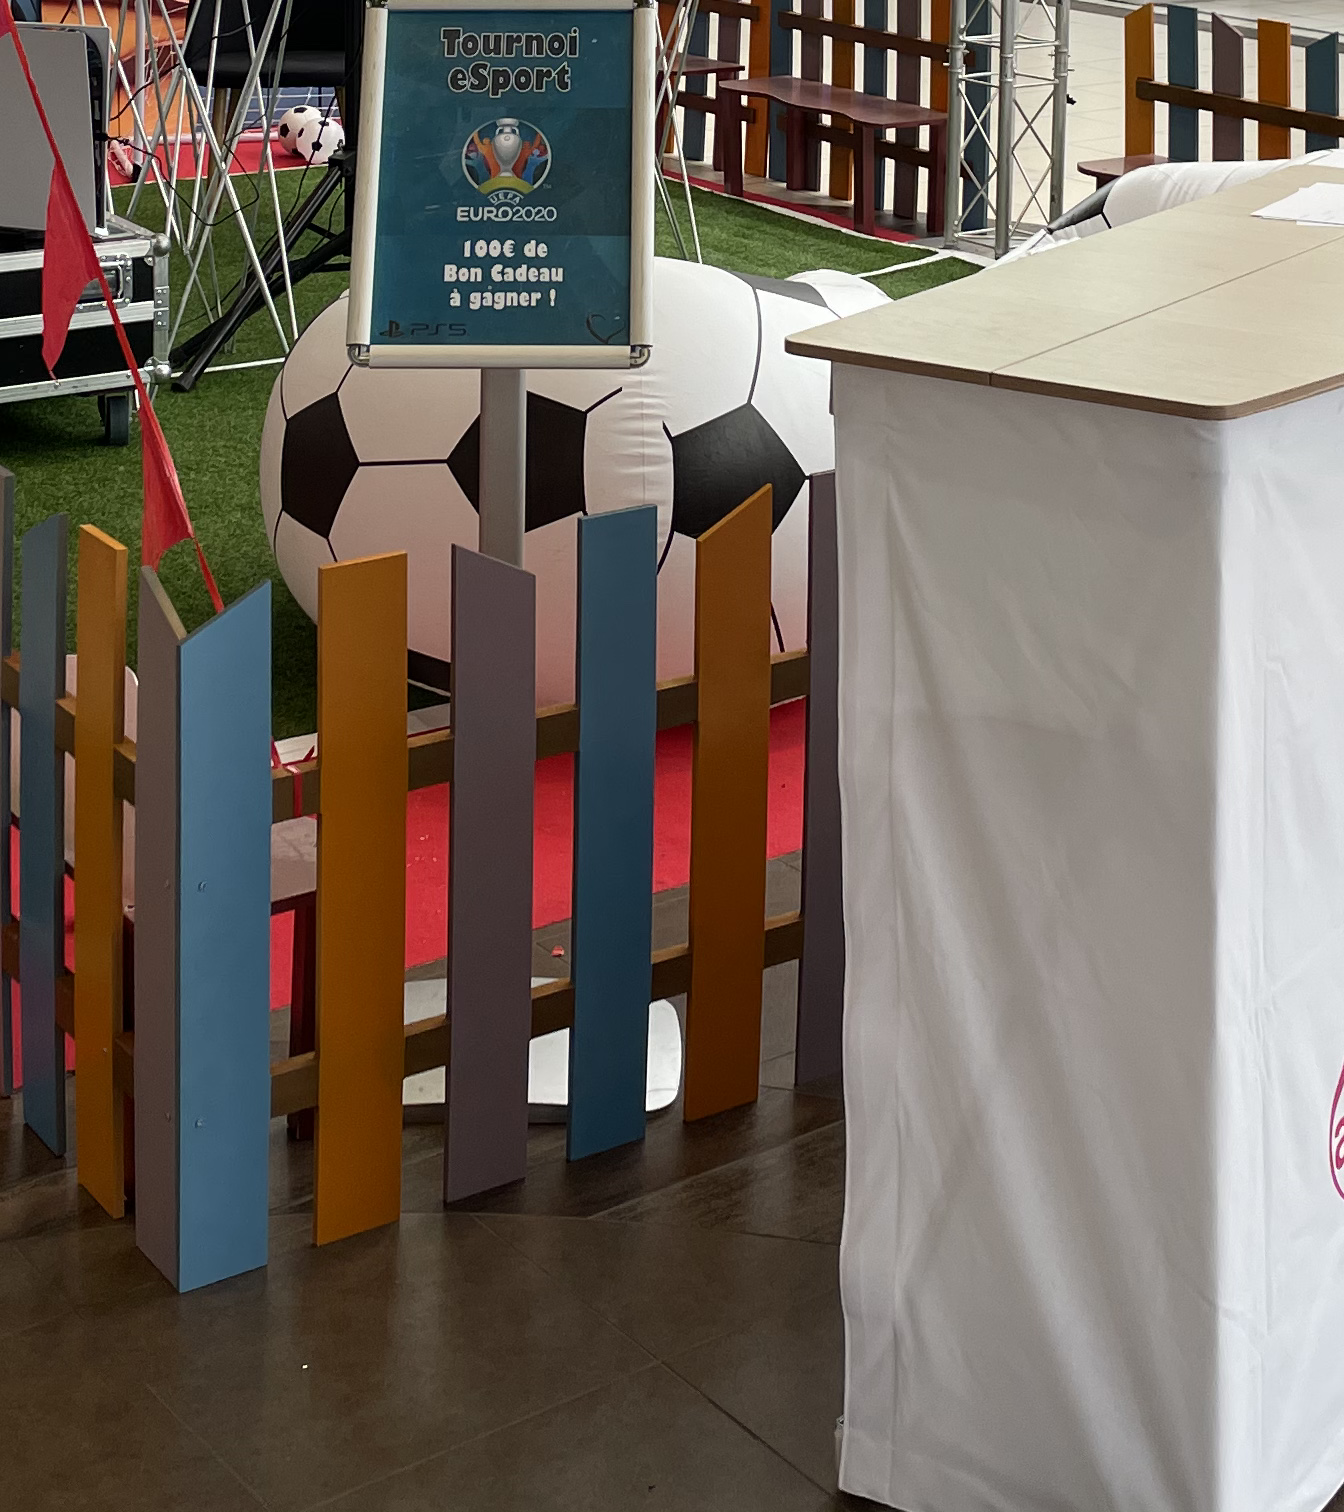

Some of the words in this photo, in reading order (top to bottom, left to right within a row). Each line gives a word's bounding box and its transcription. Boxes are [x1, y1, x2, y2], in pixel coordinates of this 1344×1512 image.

[441, 27, 579, 57] Tournoi
[448, 61, 571, 98] eSport
[489, 192, 521, 205] UEFA
[463, 240, 515, 259] 100€
[524, 240, 548, 258] de
[444, 264, 482, 283] Bon
[490, 264, 564, 283] Cadeau
[449, 288, 461, 307] à
[469, 291, 542, 310] gagner
[410, 323, 467, 336] PS5
